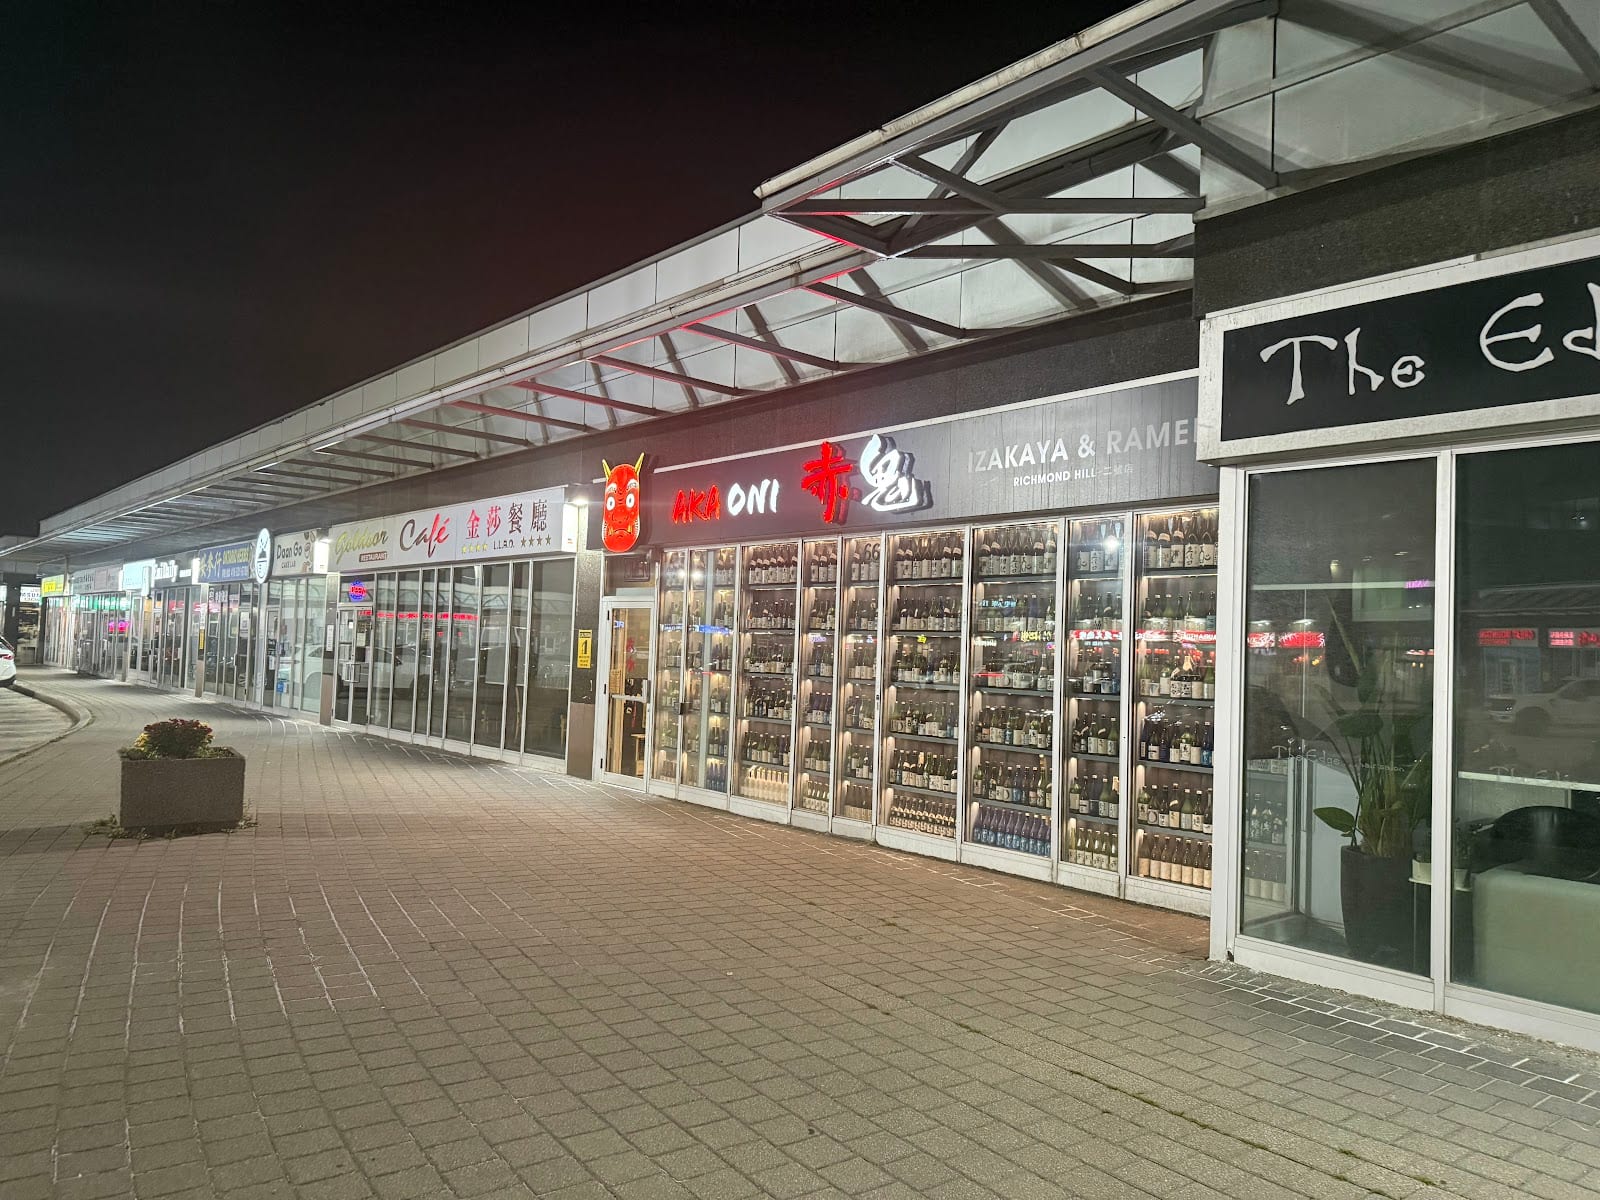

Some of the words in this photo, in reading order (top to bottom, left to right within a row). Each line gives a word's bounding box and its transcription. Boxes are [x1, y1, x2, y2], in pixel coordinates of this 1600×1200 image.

[1259, 327, 1426, 405] The
[968, 437, 1068, 473] IZAKAYA
[1077, 434, 1096, 458] &
[1106, 417, 1198, 455] RAME
[800, 433, 921, 524] 赤鬼
[1013, 470, 1071, 488] RICHMOND
[1074, 467, 1096, 479] HILL
[466, 499, 548, 539] 金莎餐廳
[672, 484, 721, 524] AKA
[727, 478, 780, 517] ONI
[400, 513, 450, 558] Café
